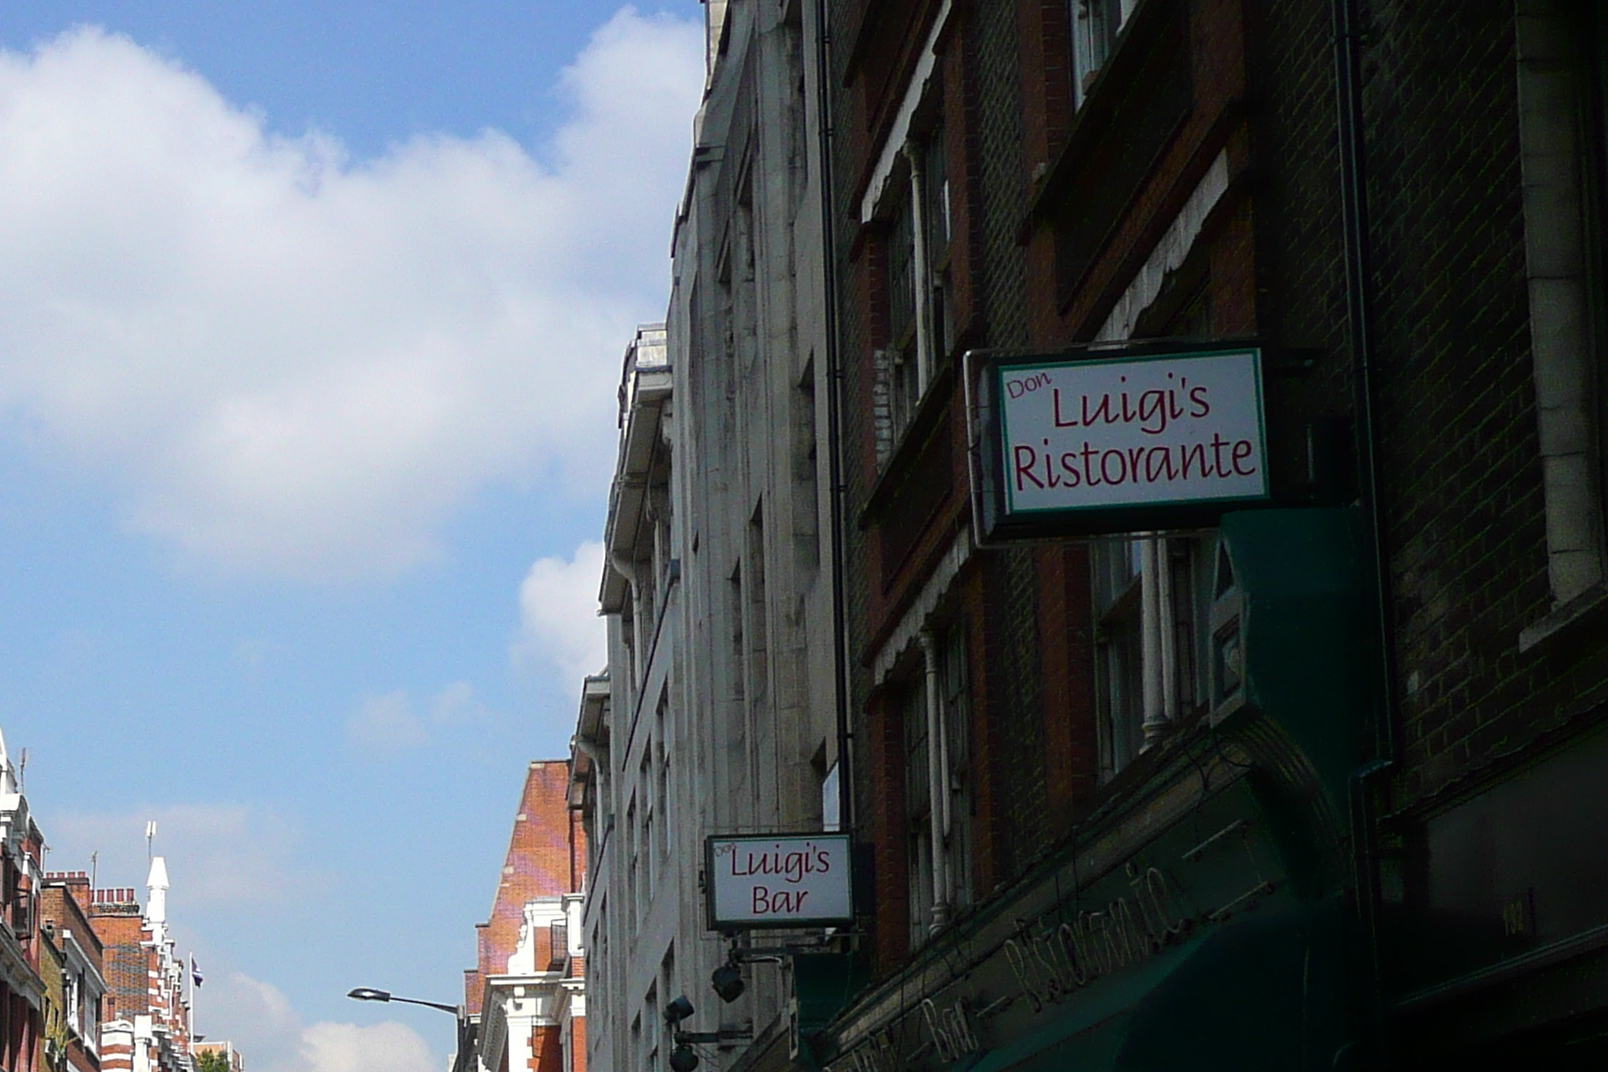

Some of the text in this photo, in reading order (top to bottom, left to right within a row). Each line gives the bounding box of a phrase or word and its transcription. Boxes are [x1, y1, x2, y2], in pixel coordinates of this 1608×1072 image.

[1006, 371, 1052, 399] Don
[1052, 372, 1211, 435] Luigi's
[1013, 432, 1257, 492] Ristorante
[731, 841, 830, 884] Luigi's
[752, 886, 809, 915] Bar
